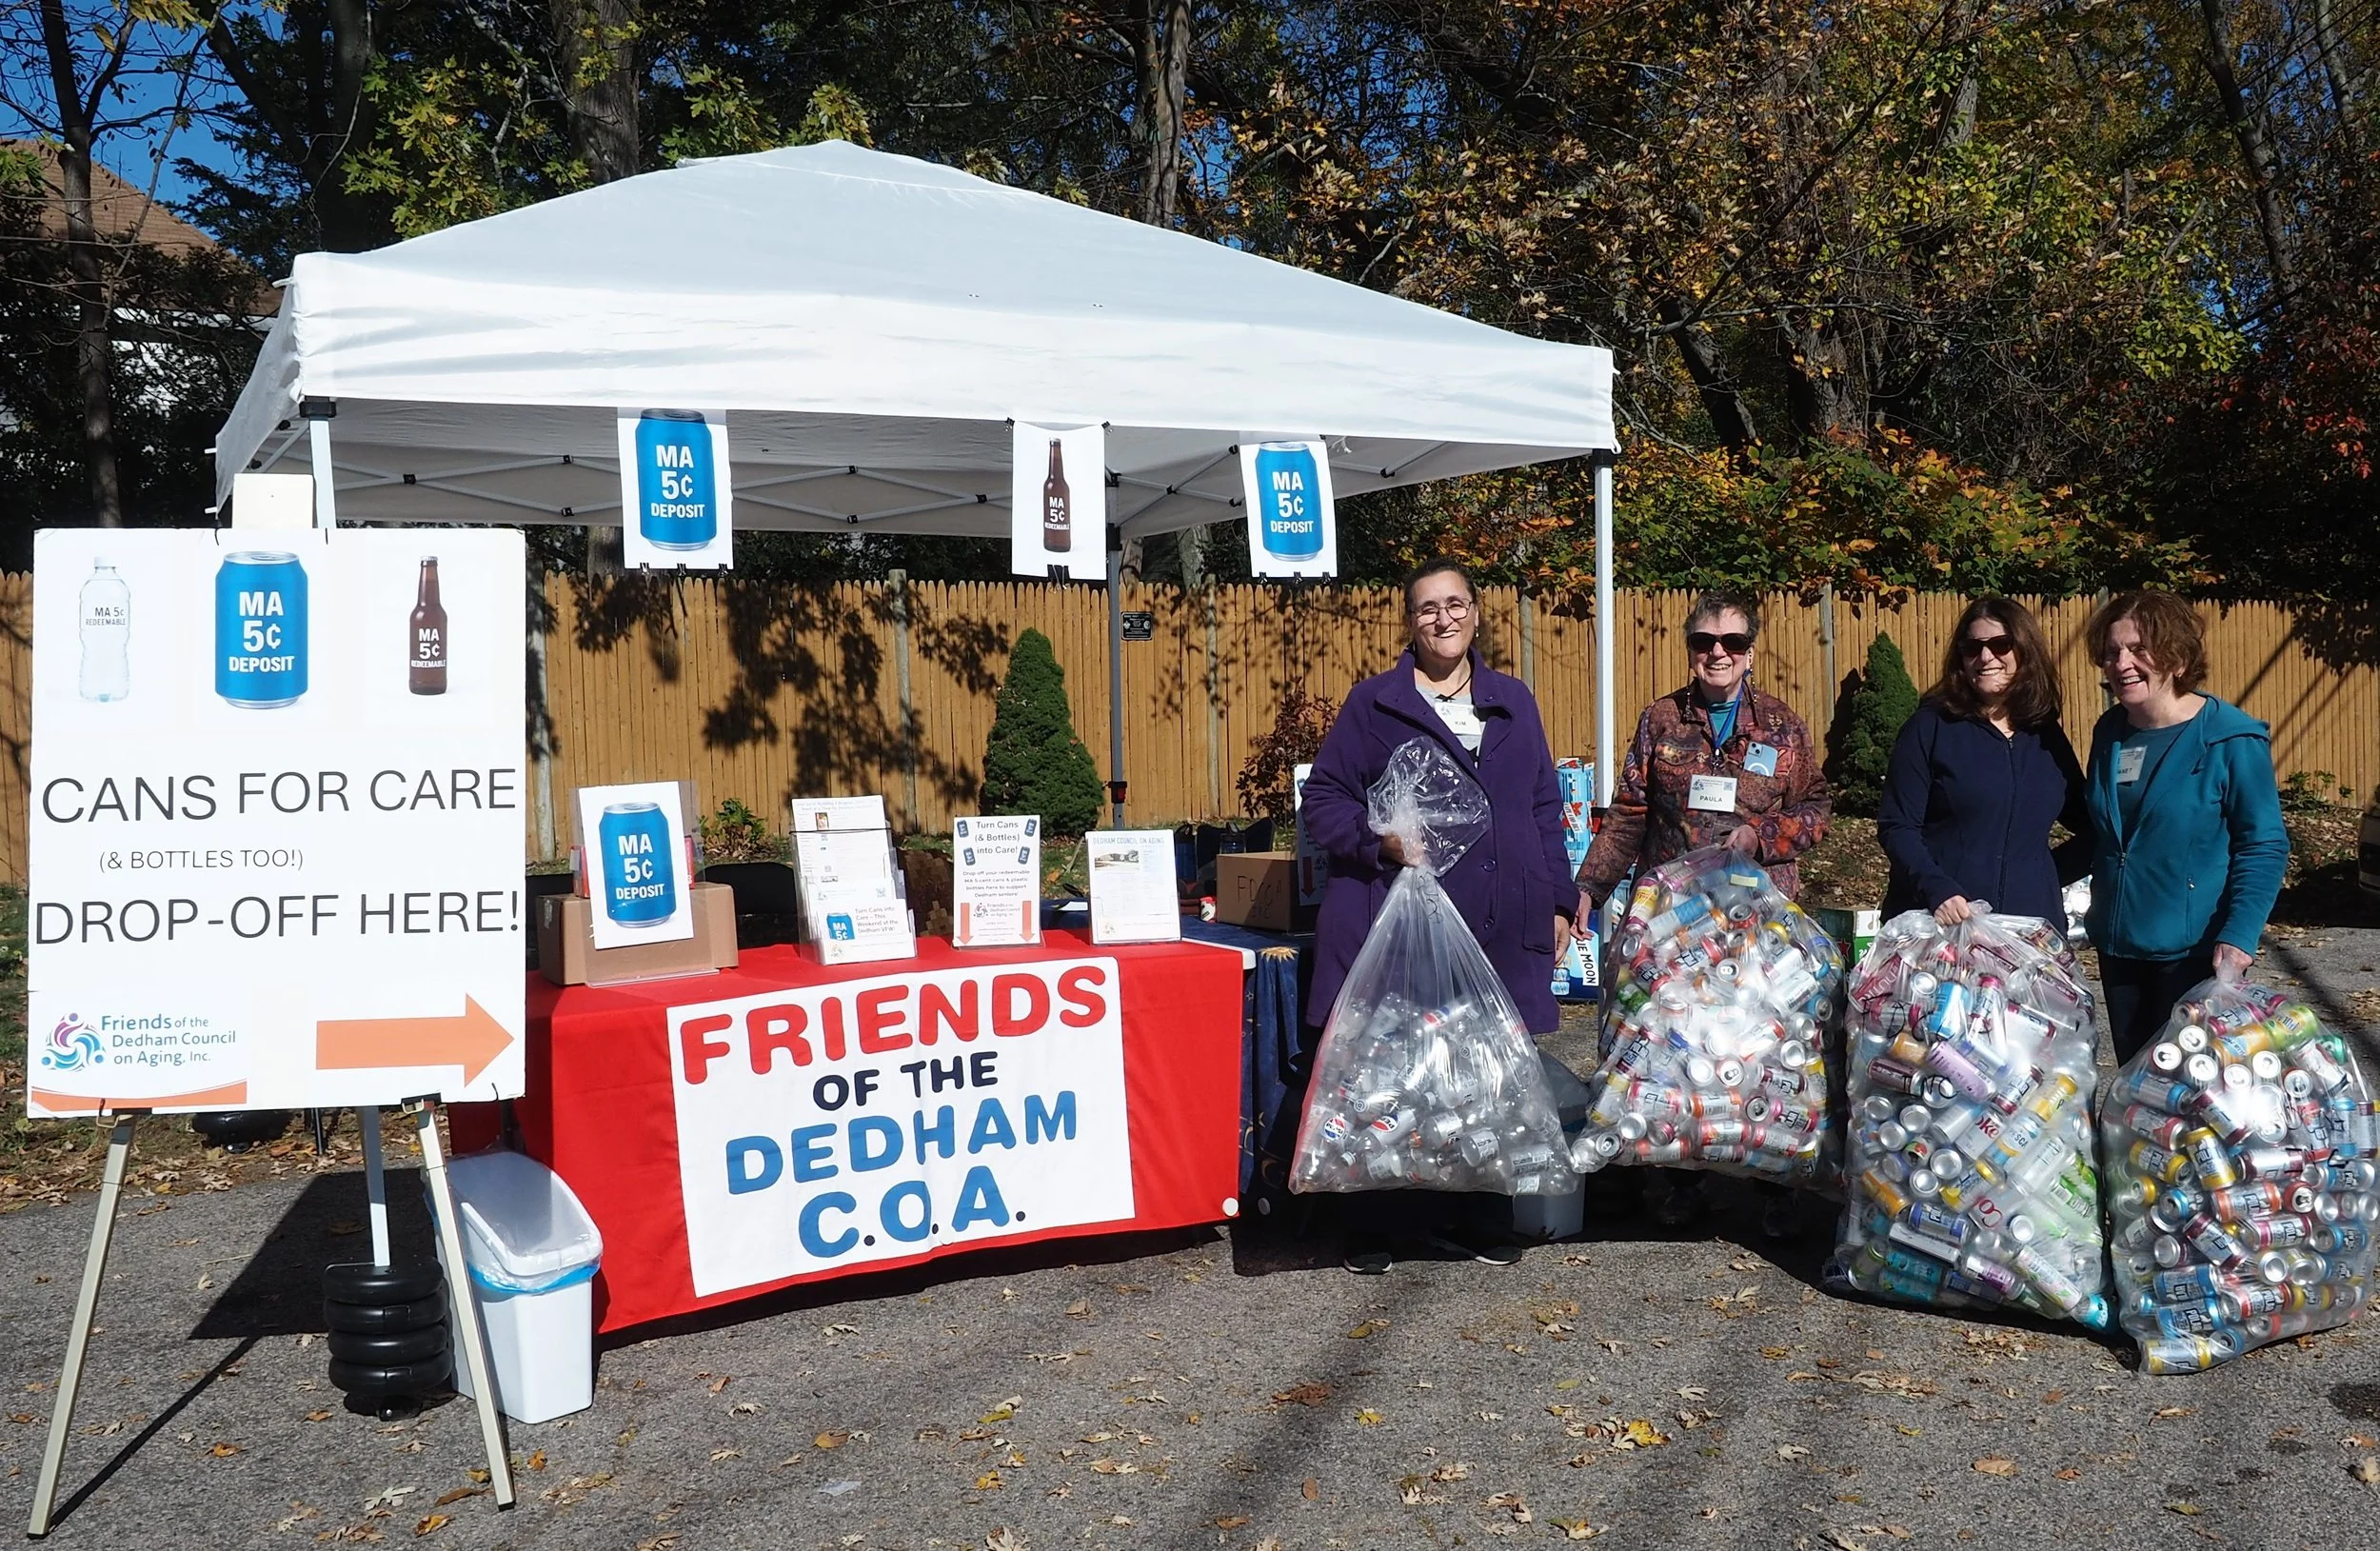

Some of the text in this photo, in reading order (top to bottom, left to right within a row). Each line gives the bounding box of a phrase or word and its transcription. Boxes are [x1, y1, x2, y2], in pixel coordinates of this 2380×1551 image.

[656, 445, 694, 468] MA
[661, 470, 693, 500] 5¢
[1272, 471, 1304, 490] MA
[650, 503, 705, 518] DEPOSIT
[1049, 496, 1064, 508] MA
[1278, 492, 1304, 518] 5¢
[1050, 508, 1065, 523] 5¢
[1270, 520, 1314, 533] DEPOSIT
[94, 606, 110, 617] MA
[239, 591, 284, 617] MA
[86, 618, 127, 626] REDEEMABLE
[243, 620, 282, 653] 5¢
[419, 628, 440, 642] MA
[419, 643, 440, 660] 5¢
[228, 655, 295, 672] DEPOSIT
[42, 767, 517, 825] CANS FOR CARE
[618, 833, 653, 856] MA
[975, 833, 1021, 843] (& Bottles)
[995, 845, 1018, 854] Care!
[99, 847, 305, 873] (& BOTTLES TOO!)
[624, 857, 653, 884] 5¢
[615, 884, 665, 901] DEPOSIT
[35, 889, 521, 945] DROP-OFF HERE!
[832, 923, 847, 931] MA
[1580, 954, 1597, 984] MOON
[101, 1014, 209, 1031] Friends of the
[680, 966, 1107, 1085] FRIENDS
[112, 1030, 236, 1047] Dedham Council
[113, 1054, 132, 1065] on
[189, 1051, 211, 1062] Inc.
[813, 1051, 999, 1111] OF THE
[725, 1090, 1078, 1197] DEDHAM
[798, 1165, 1027, 1260] C.O.A.
